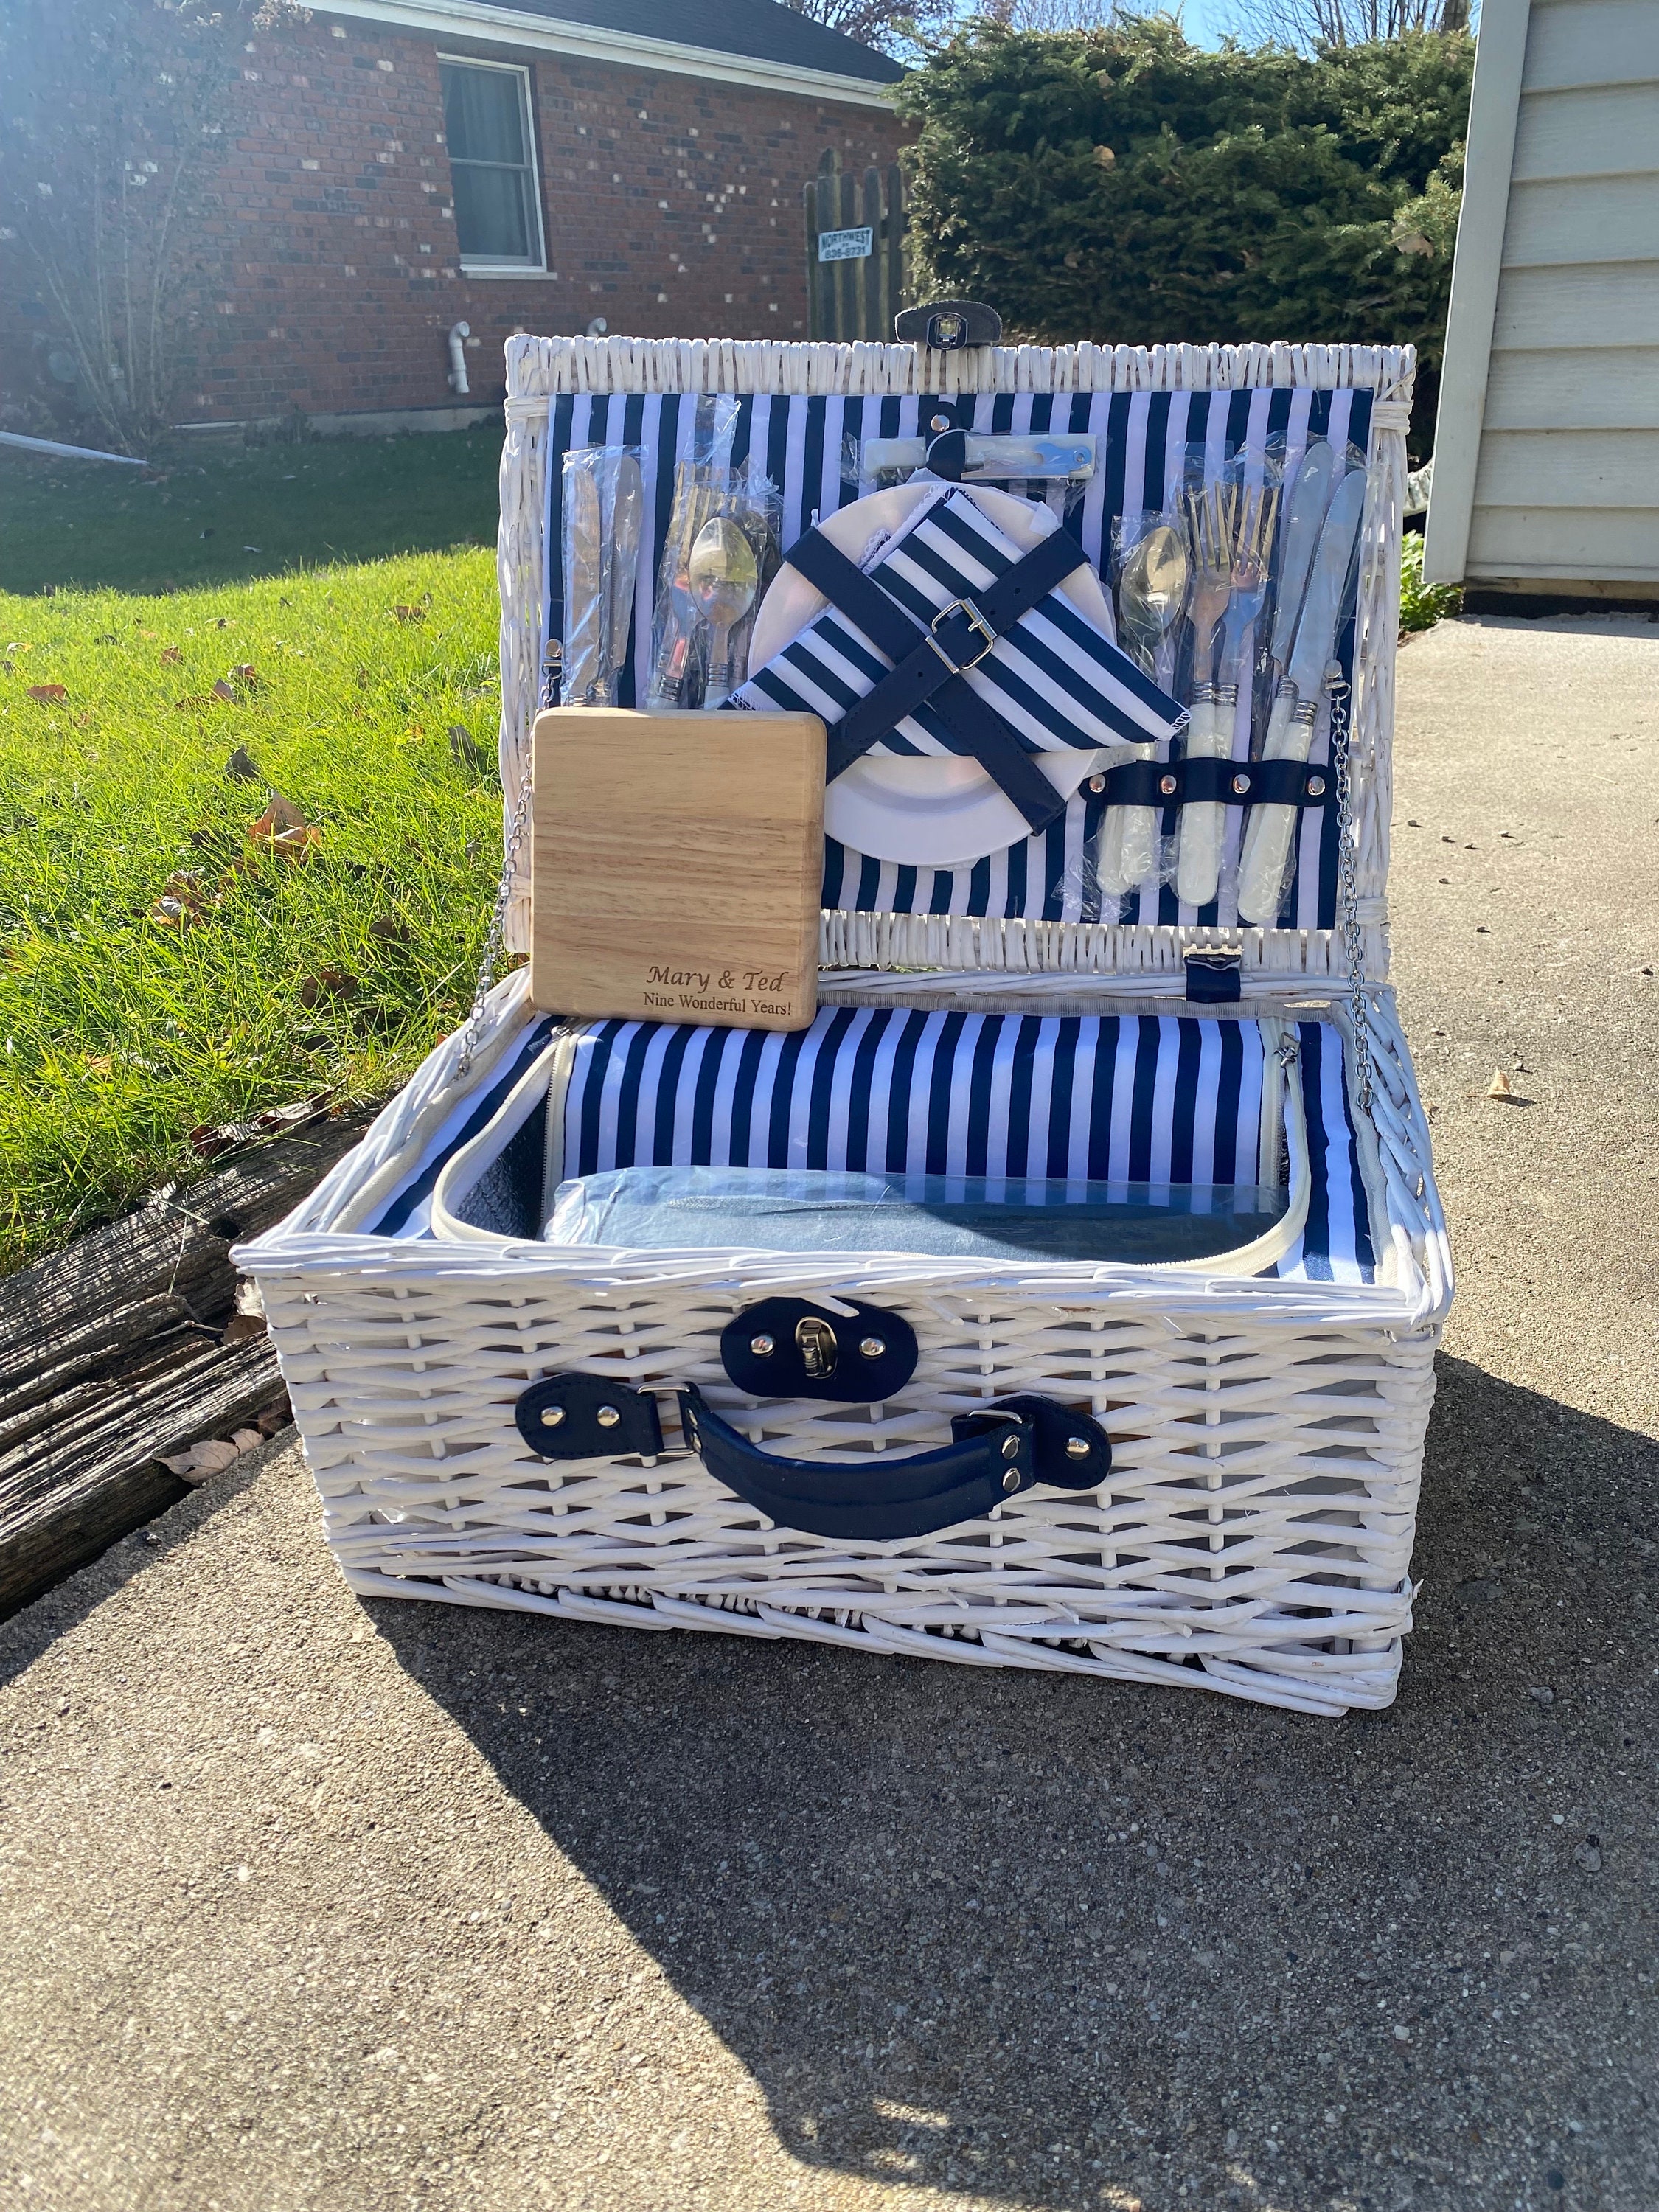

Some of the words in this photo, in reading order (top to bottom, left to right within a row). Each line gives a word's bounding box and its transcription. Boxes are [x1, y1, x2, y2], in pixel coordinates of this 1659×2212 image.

[821, 230, 870, 251] NORTHWEST
[646, 966, 711, 994] Mary
[718, 970, 735, 990] &
[742, 970, 790, 992] Ted
[643, 992, 675, 1007] Nine
[678, 994, 746, 1012] Wonderful
[751, 999, 792, 1015] Years!
